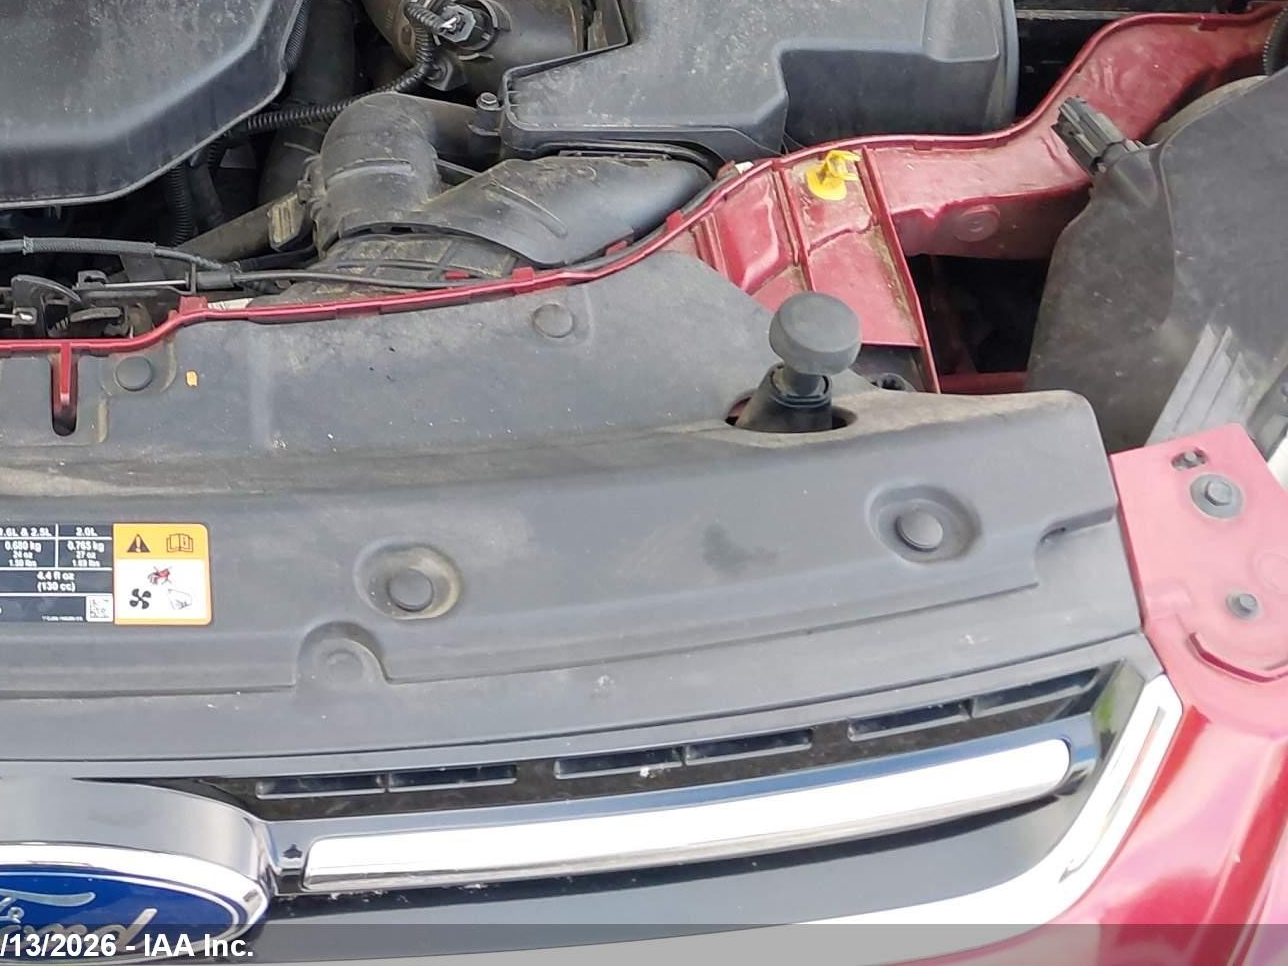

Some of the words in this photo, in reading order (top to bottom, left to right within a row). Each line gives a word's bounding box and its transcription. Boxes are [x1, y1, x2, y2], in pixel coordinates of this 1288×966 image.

[20, 527, 29, 537] &
[30, 527, 52, 537] 2.5L
[75, 526, 98, 537] 2.0L
[30, 540, 42, 553] kg
[92, 540, 105, 553] kg
[36, 571, 52, 580] 4.4
[53, 571, 61, 580] fl
[62, 572, 75, 580] oz
[37, 581, 58, 592] (130
[59, 581, 76, 592] cc)
